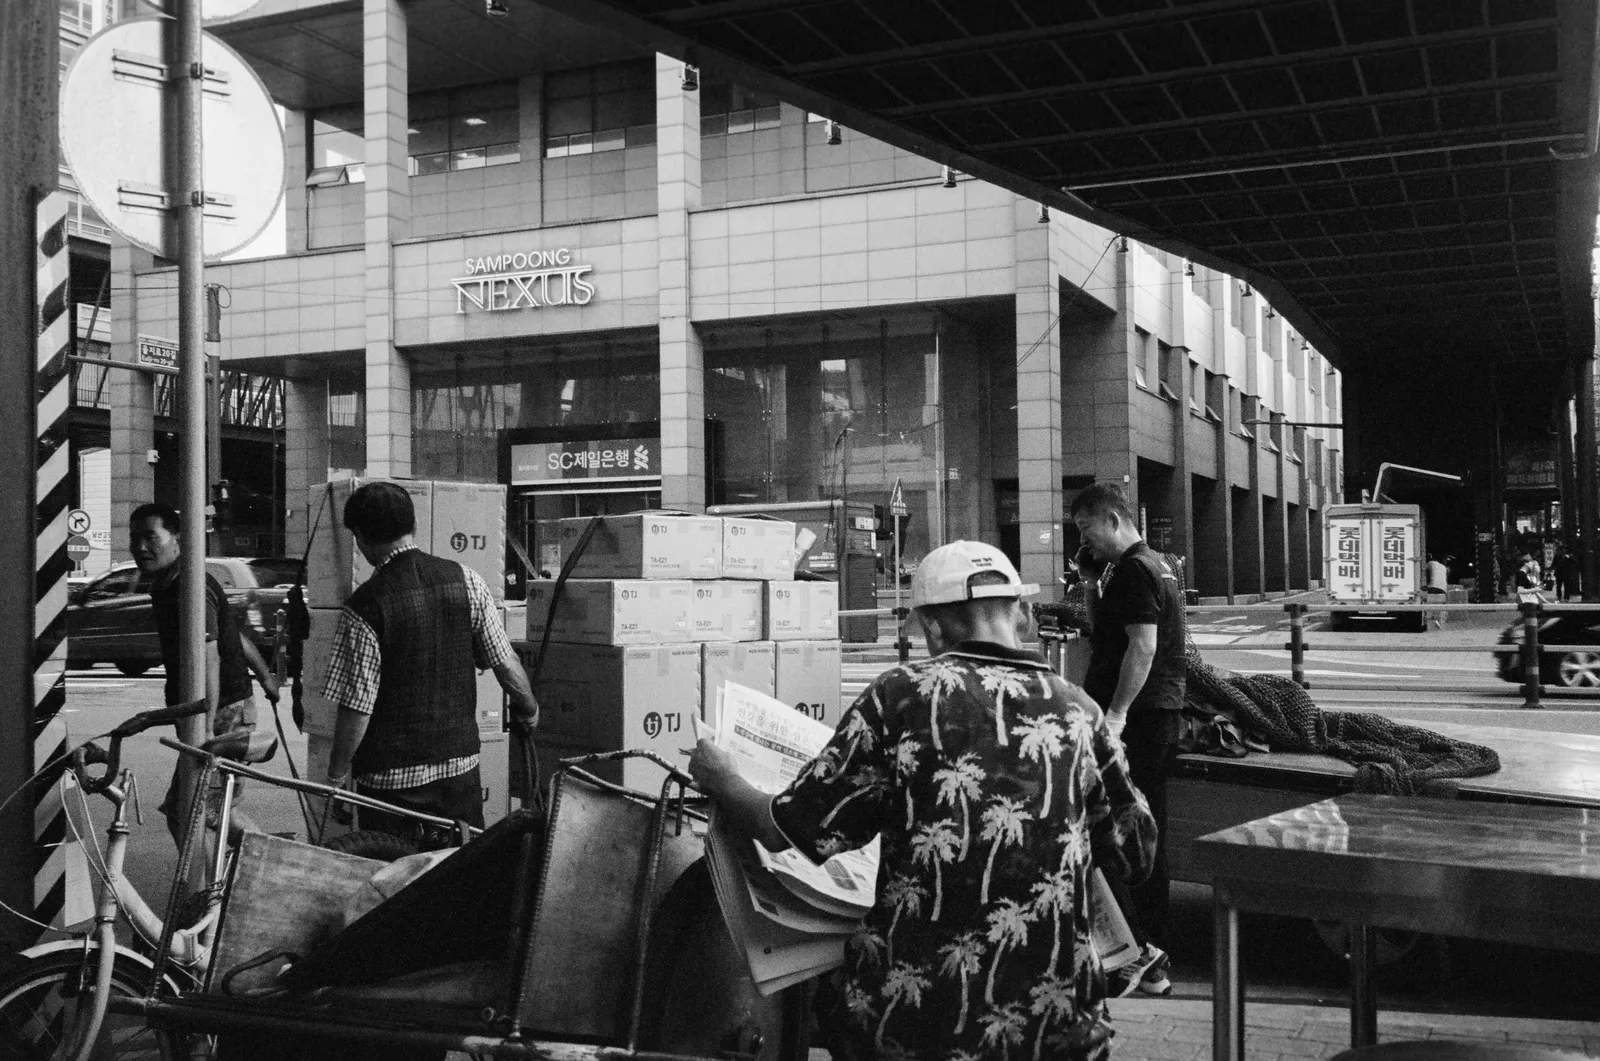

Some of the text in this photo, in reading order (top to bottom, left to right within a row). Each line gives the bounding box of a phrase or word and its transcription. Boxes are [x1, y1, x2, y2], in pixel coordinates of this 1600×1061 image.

[465, 248, 571, 275] SAMPOONG
[451, 265, 595, 314] NEXUS
[142, 345, 176, 360] 을지로20길
[548, 449, 629, 470] SC제일은행
[470, 535, 486, 551] TJ
[1338, 527, 1360, 578] 롯데택배
[1383, 527, 1405, 579] 롯데택배
[664, 712, 681, 732] TJ
[811, 703, 825, 721] TJ
